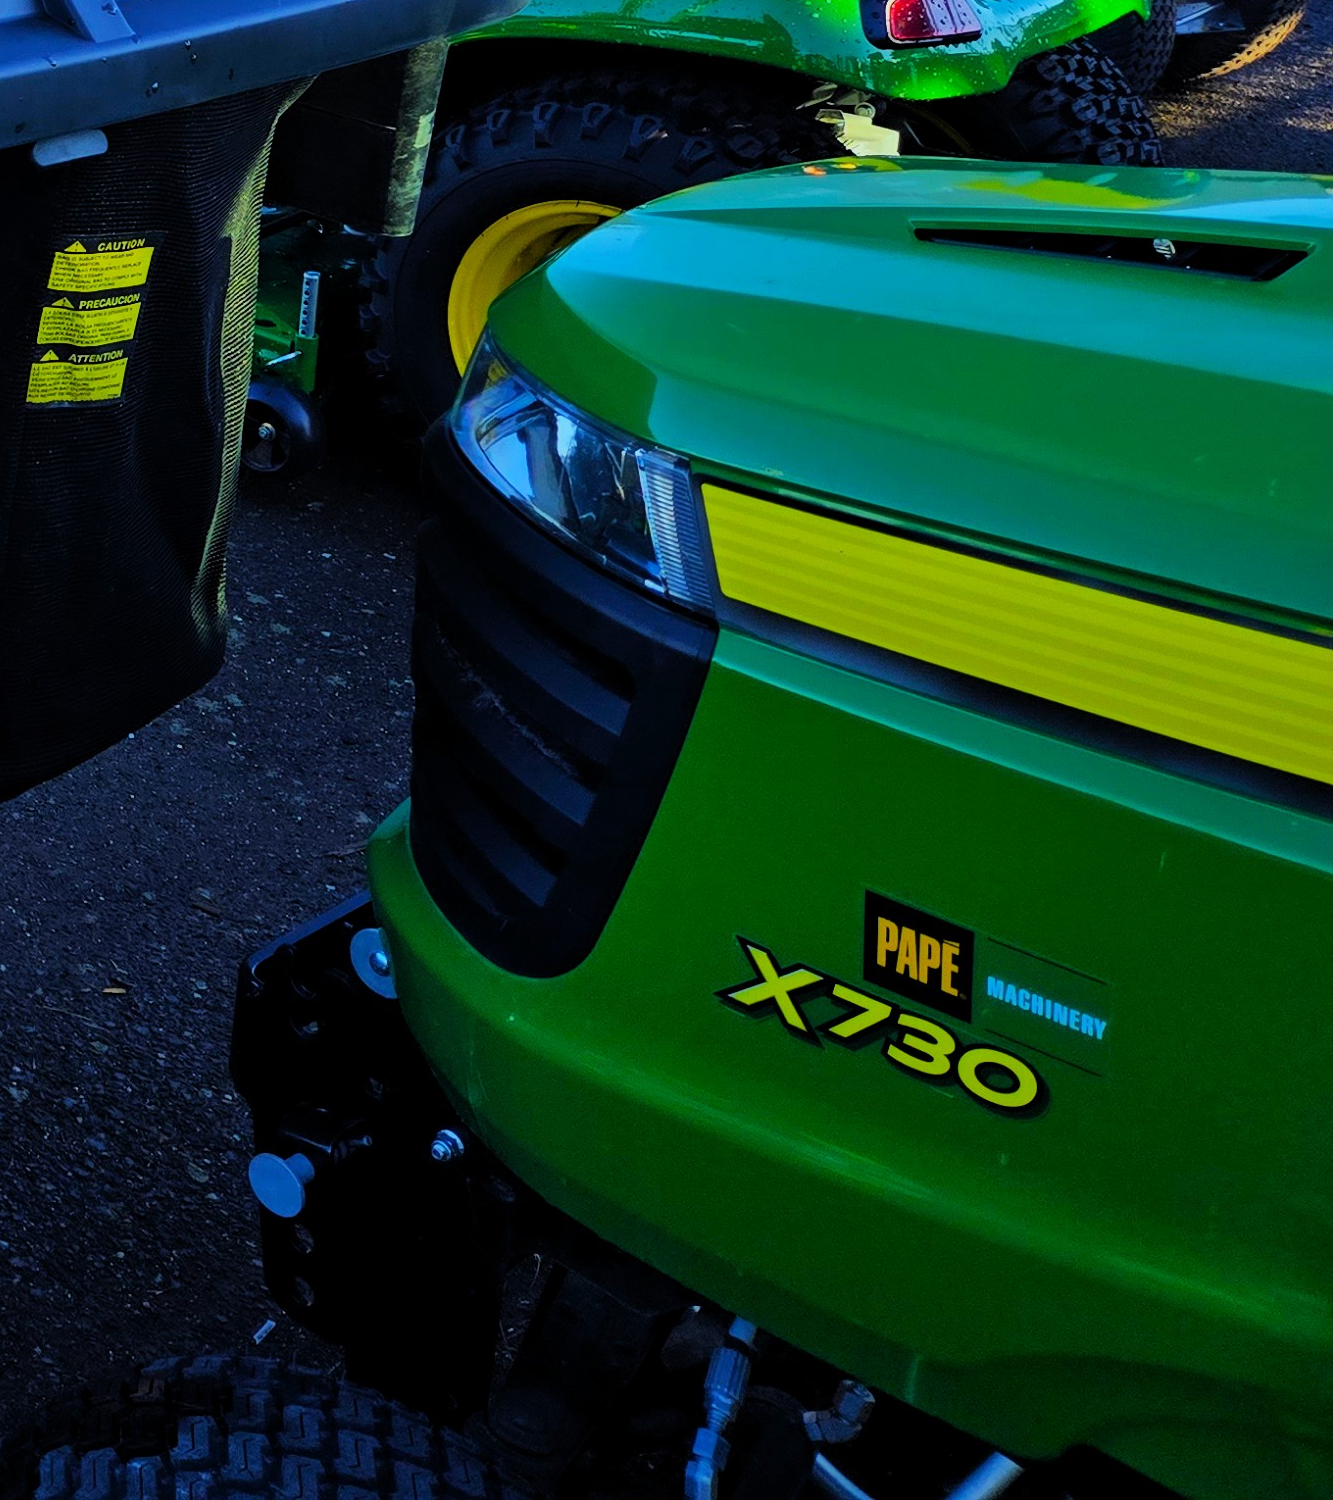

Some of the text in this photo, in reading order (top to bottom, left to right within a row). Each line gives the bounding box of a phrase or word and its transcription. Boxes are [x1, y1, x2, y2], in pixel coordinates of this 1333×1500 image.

[97, 238, 146, 252] CAUTION
[78, 293, 141, 310] PRECAUCION
[68, 349, 124, 364] ATTENTION
[877, 916, 1107, 1041] PAPÉ MACHINERY
[719, 937, 1043, 1111] X730
